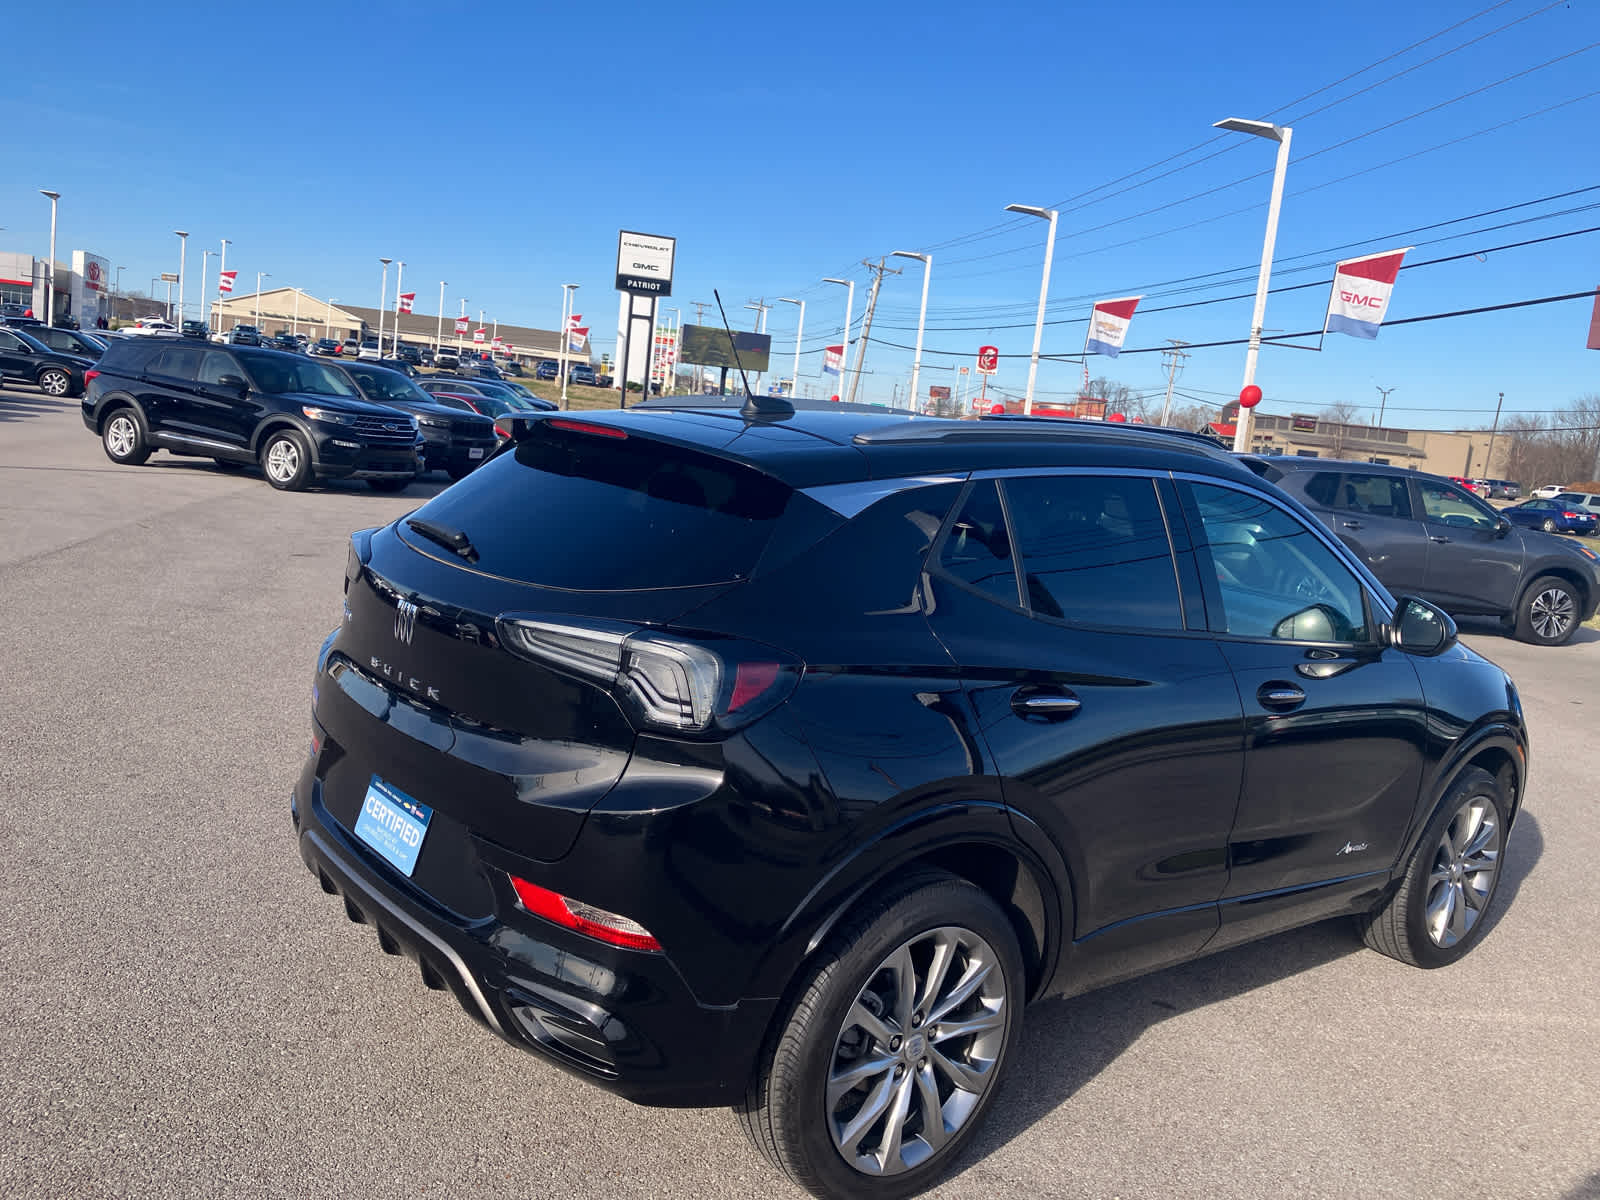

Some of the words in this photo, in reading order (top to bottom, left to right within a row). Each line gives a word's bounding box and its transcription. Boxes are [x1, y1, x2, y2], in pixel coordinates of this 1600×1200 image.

[632, 262, 660, 272] GMC
[627, 279, 662, 291] PATRIOT
[1340, 290, 1384, 309] GMC
[370, 655, 440, 701] BUICK
[365, 795, 421, 848] CERTIFIED
